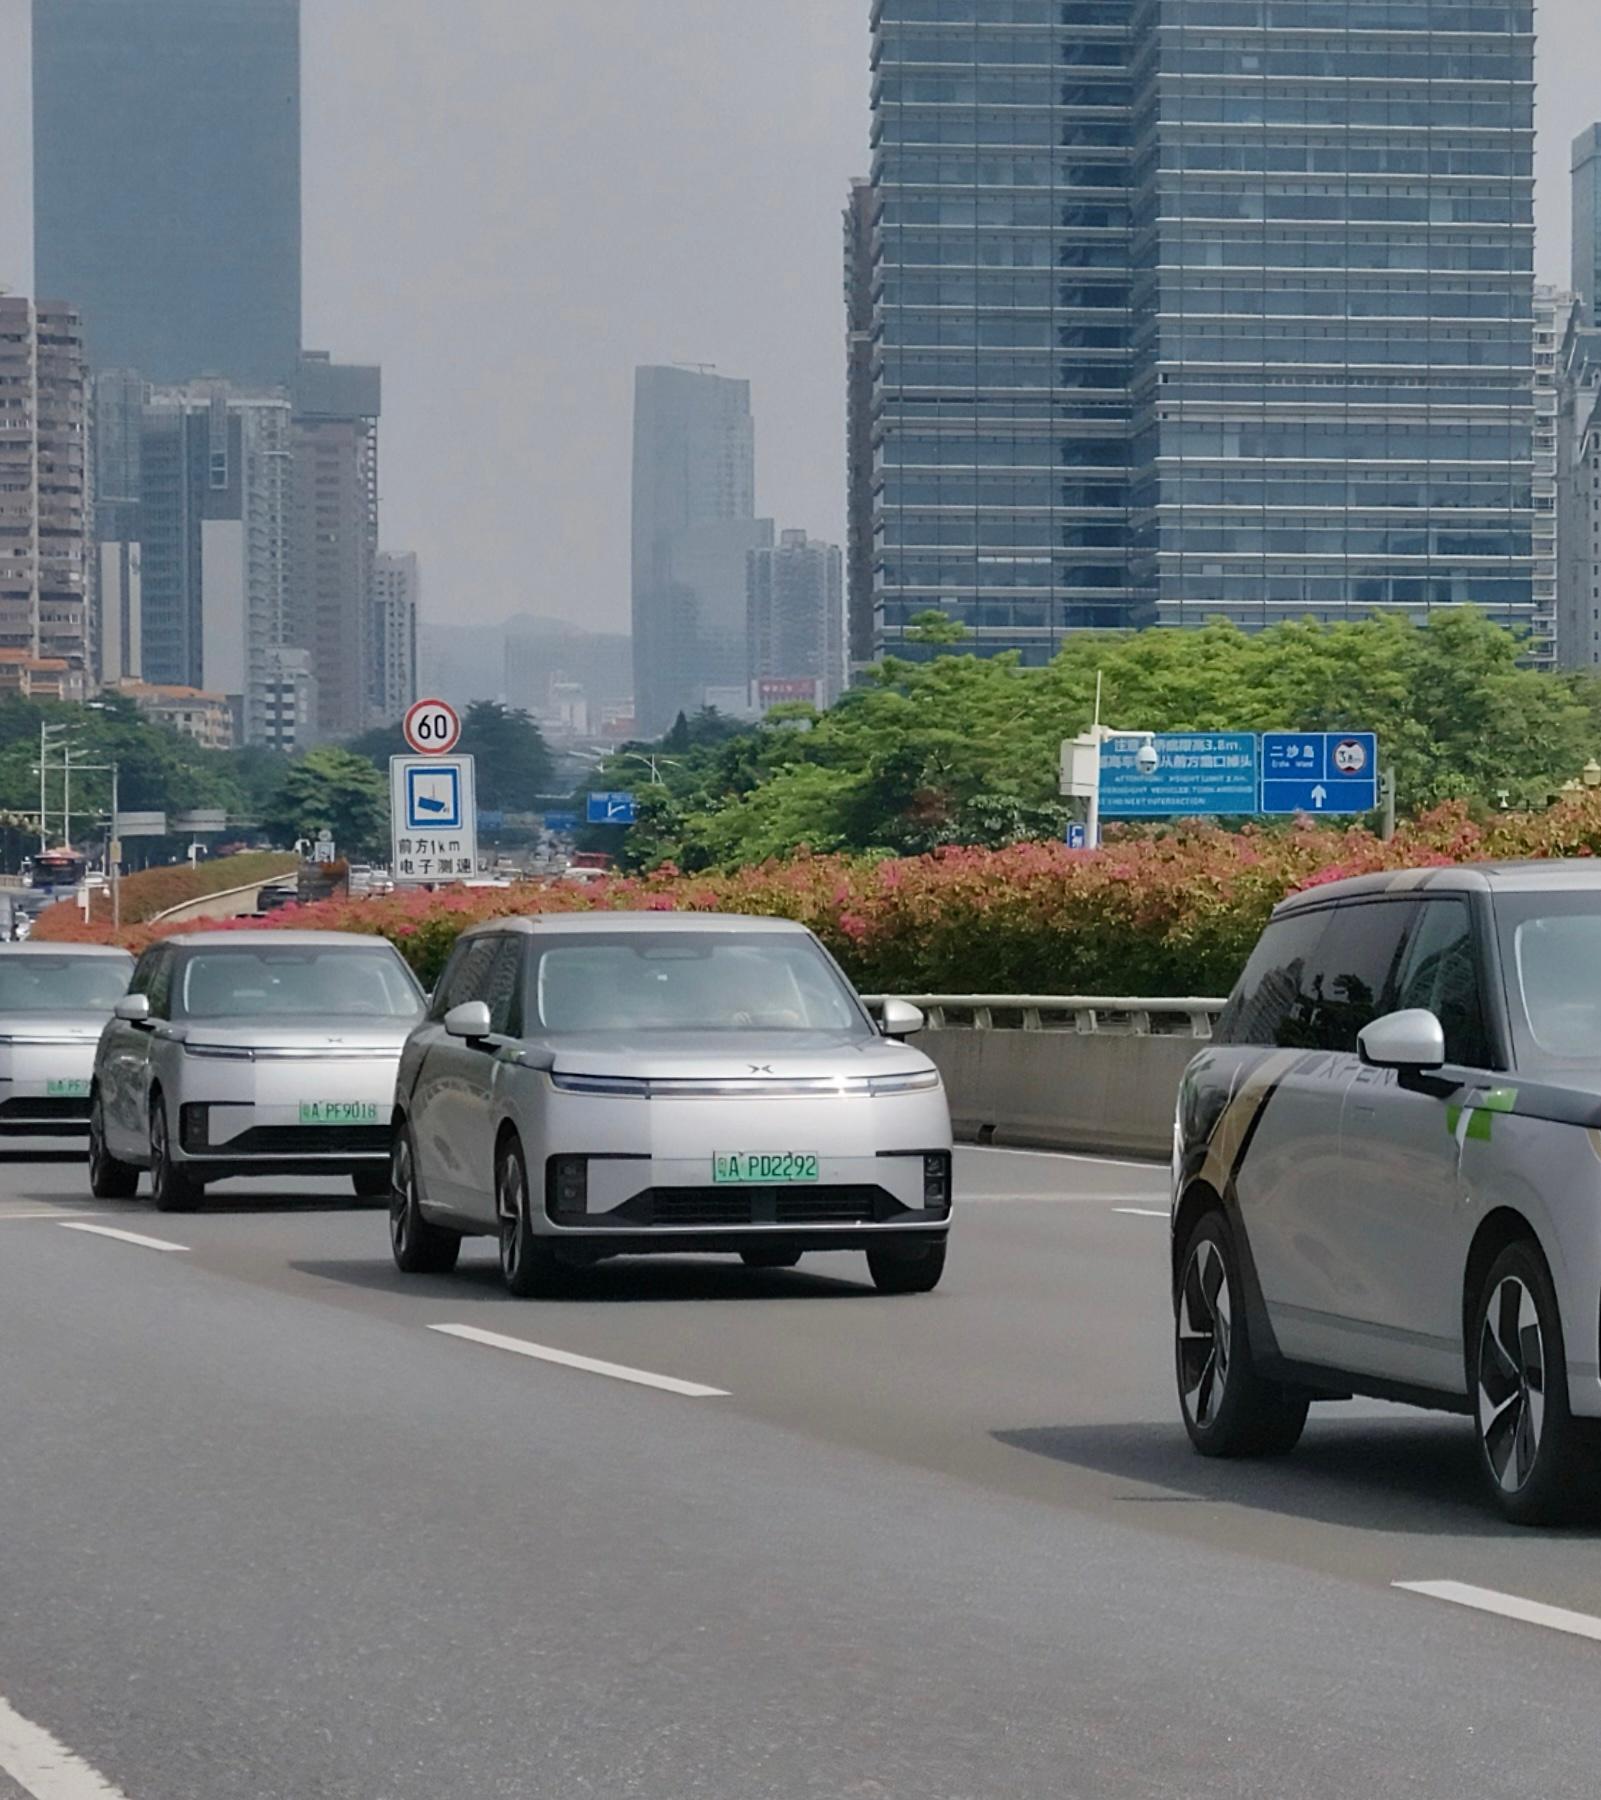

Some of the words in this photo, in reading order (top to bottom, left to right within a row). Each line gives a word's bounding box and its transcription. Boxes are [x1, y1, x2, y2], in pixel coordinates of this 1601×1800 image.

[417, 714, 448, 740] 60
[398, 838, 461, 855] 前方1km
[399, 858, 473, 875] 电子测速
[748, 1155, 816, 1177] PD2292
